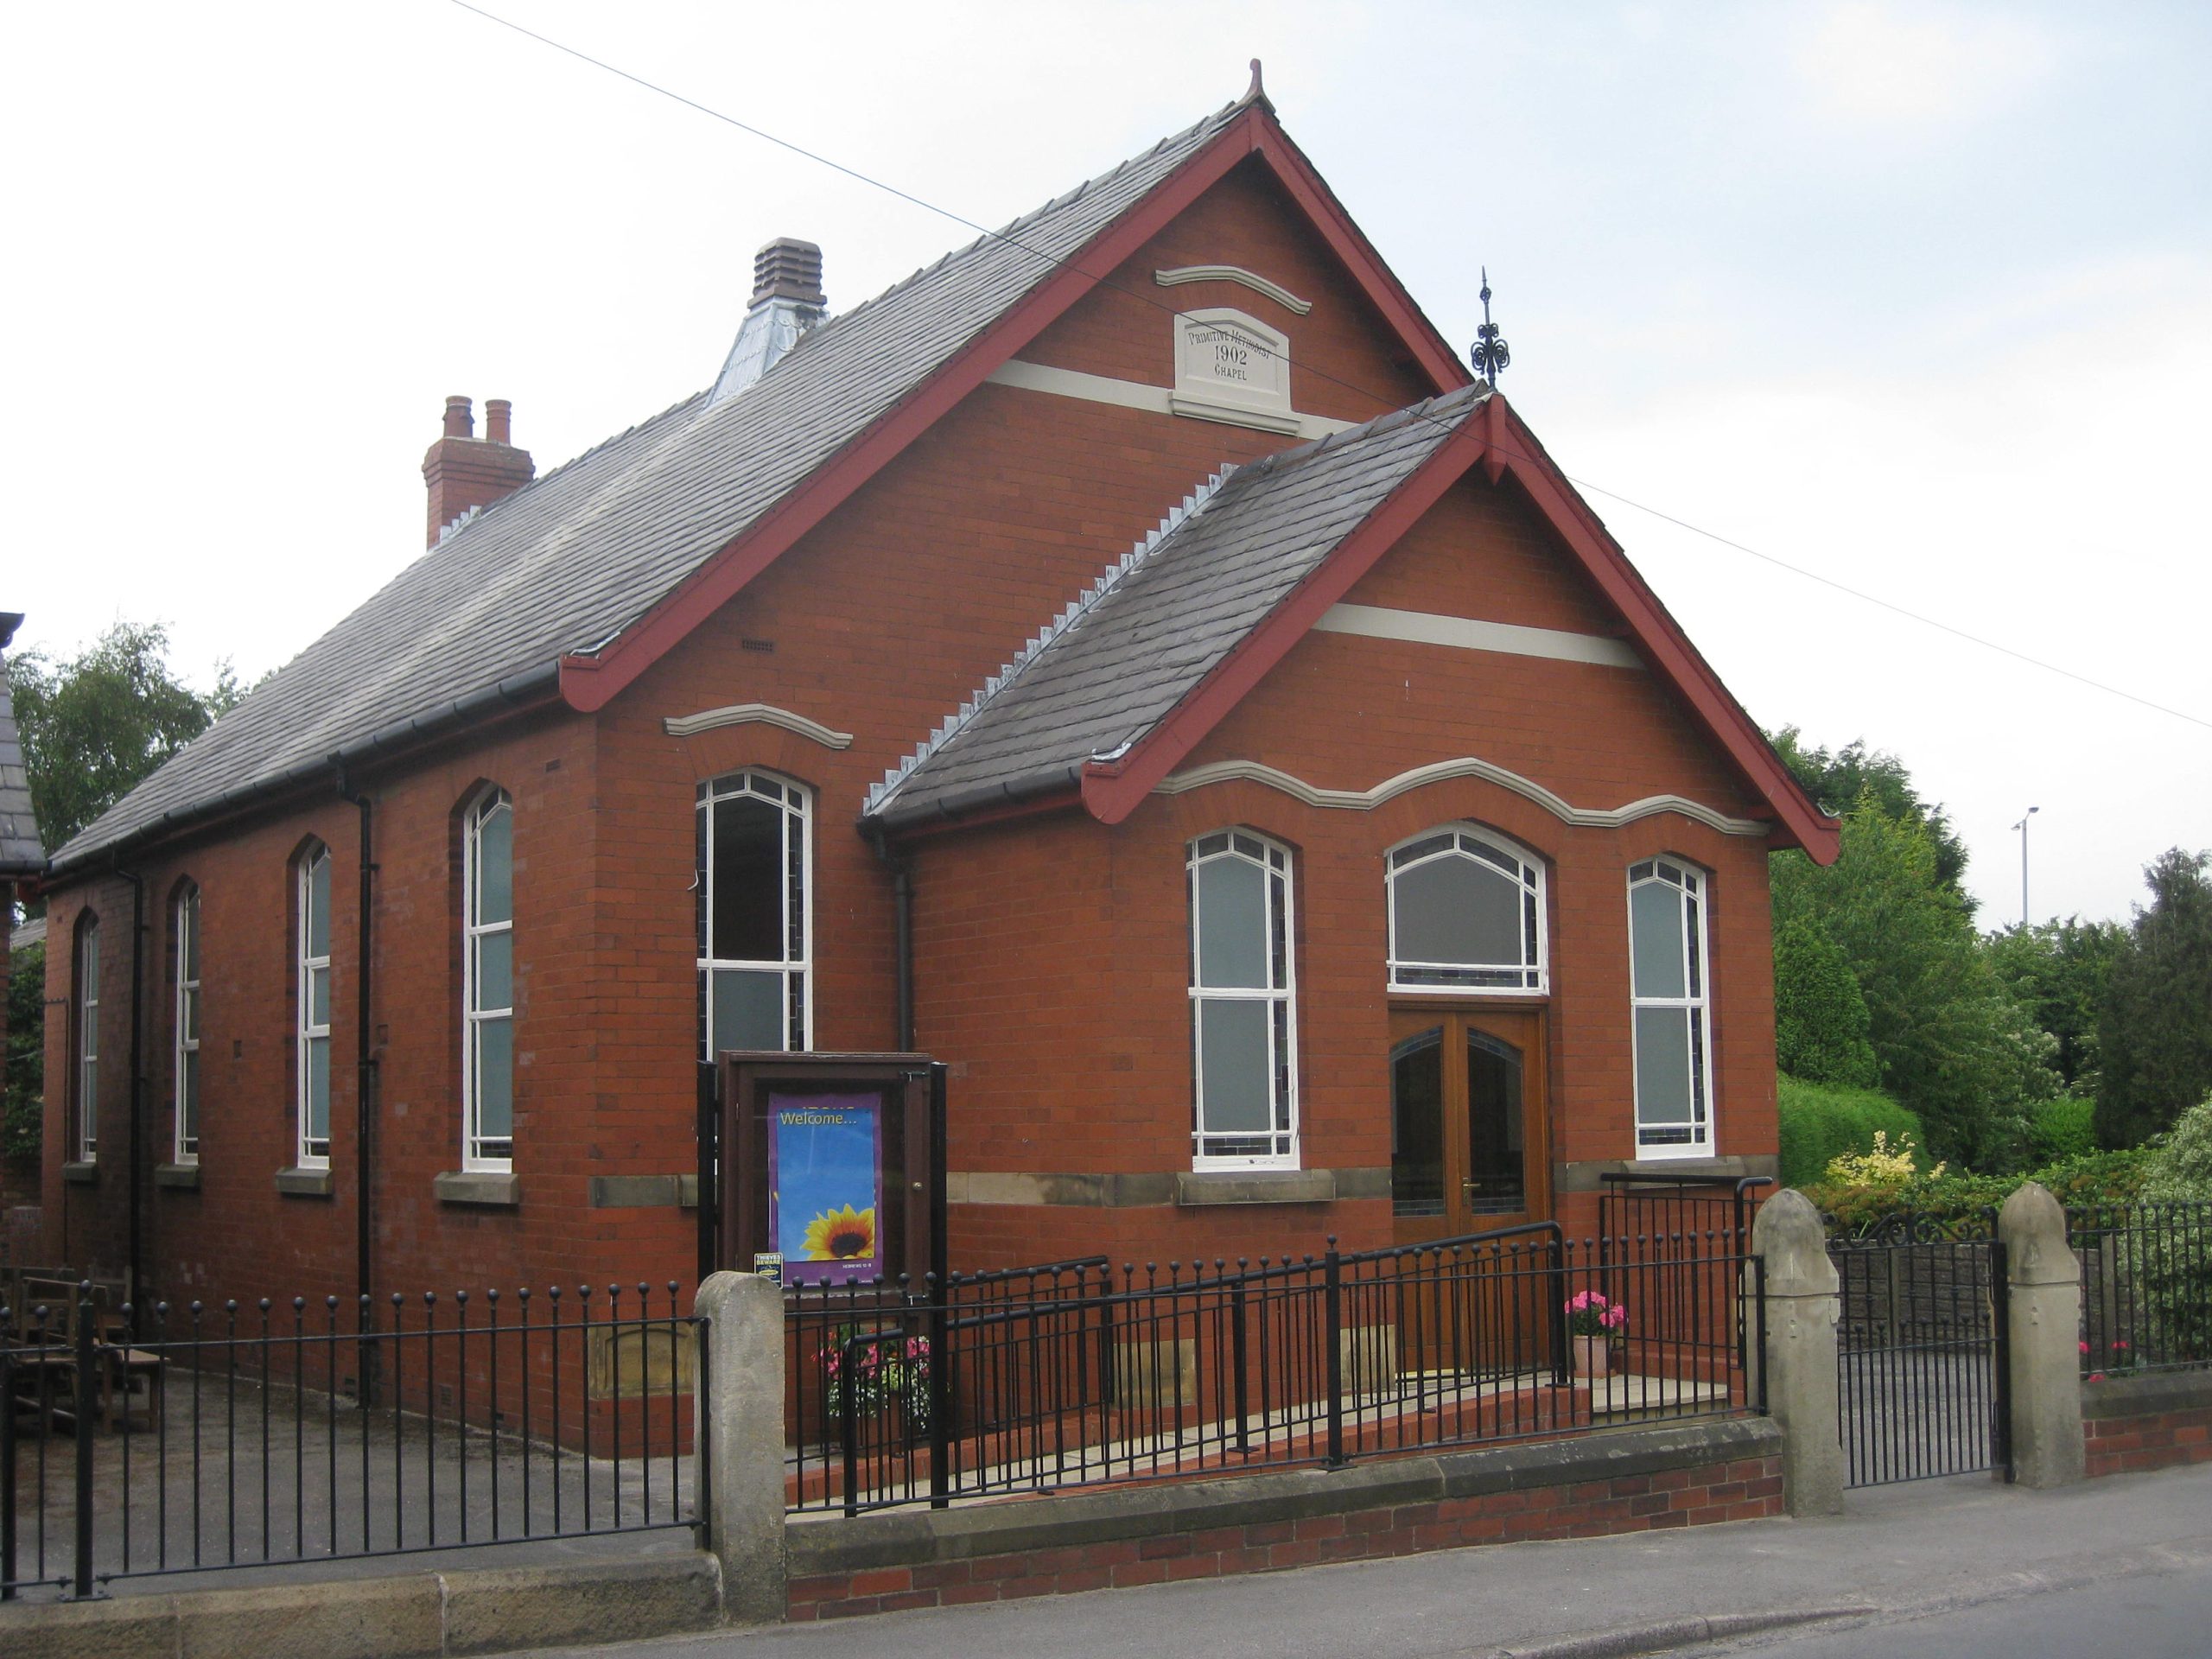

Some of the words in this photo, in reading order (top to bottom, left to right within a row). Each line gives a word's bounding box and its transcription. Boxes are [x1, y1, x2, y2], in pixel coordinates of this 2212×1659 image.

[1188, 331, 1229, 345] PRIMITIVE
[1231, 330, 1271, 359] METHODIST
[1216, 345, 1247, 365] 1902
[1215, 364, 1247, 381] CHAPEL
[780, 1111, 857, 1125] Welcome...
